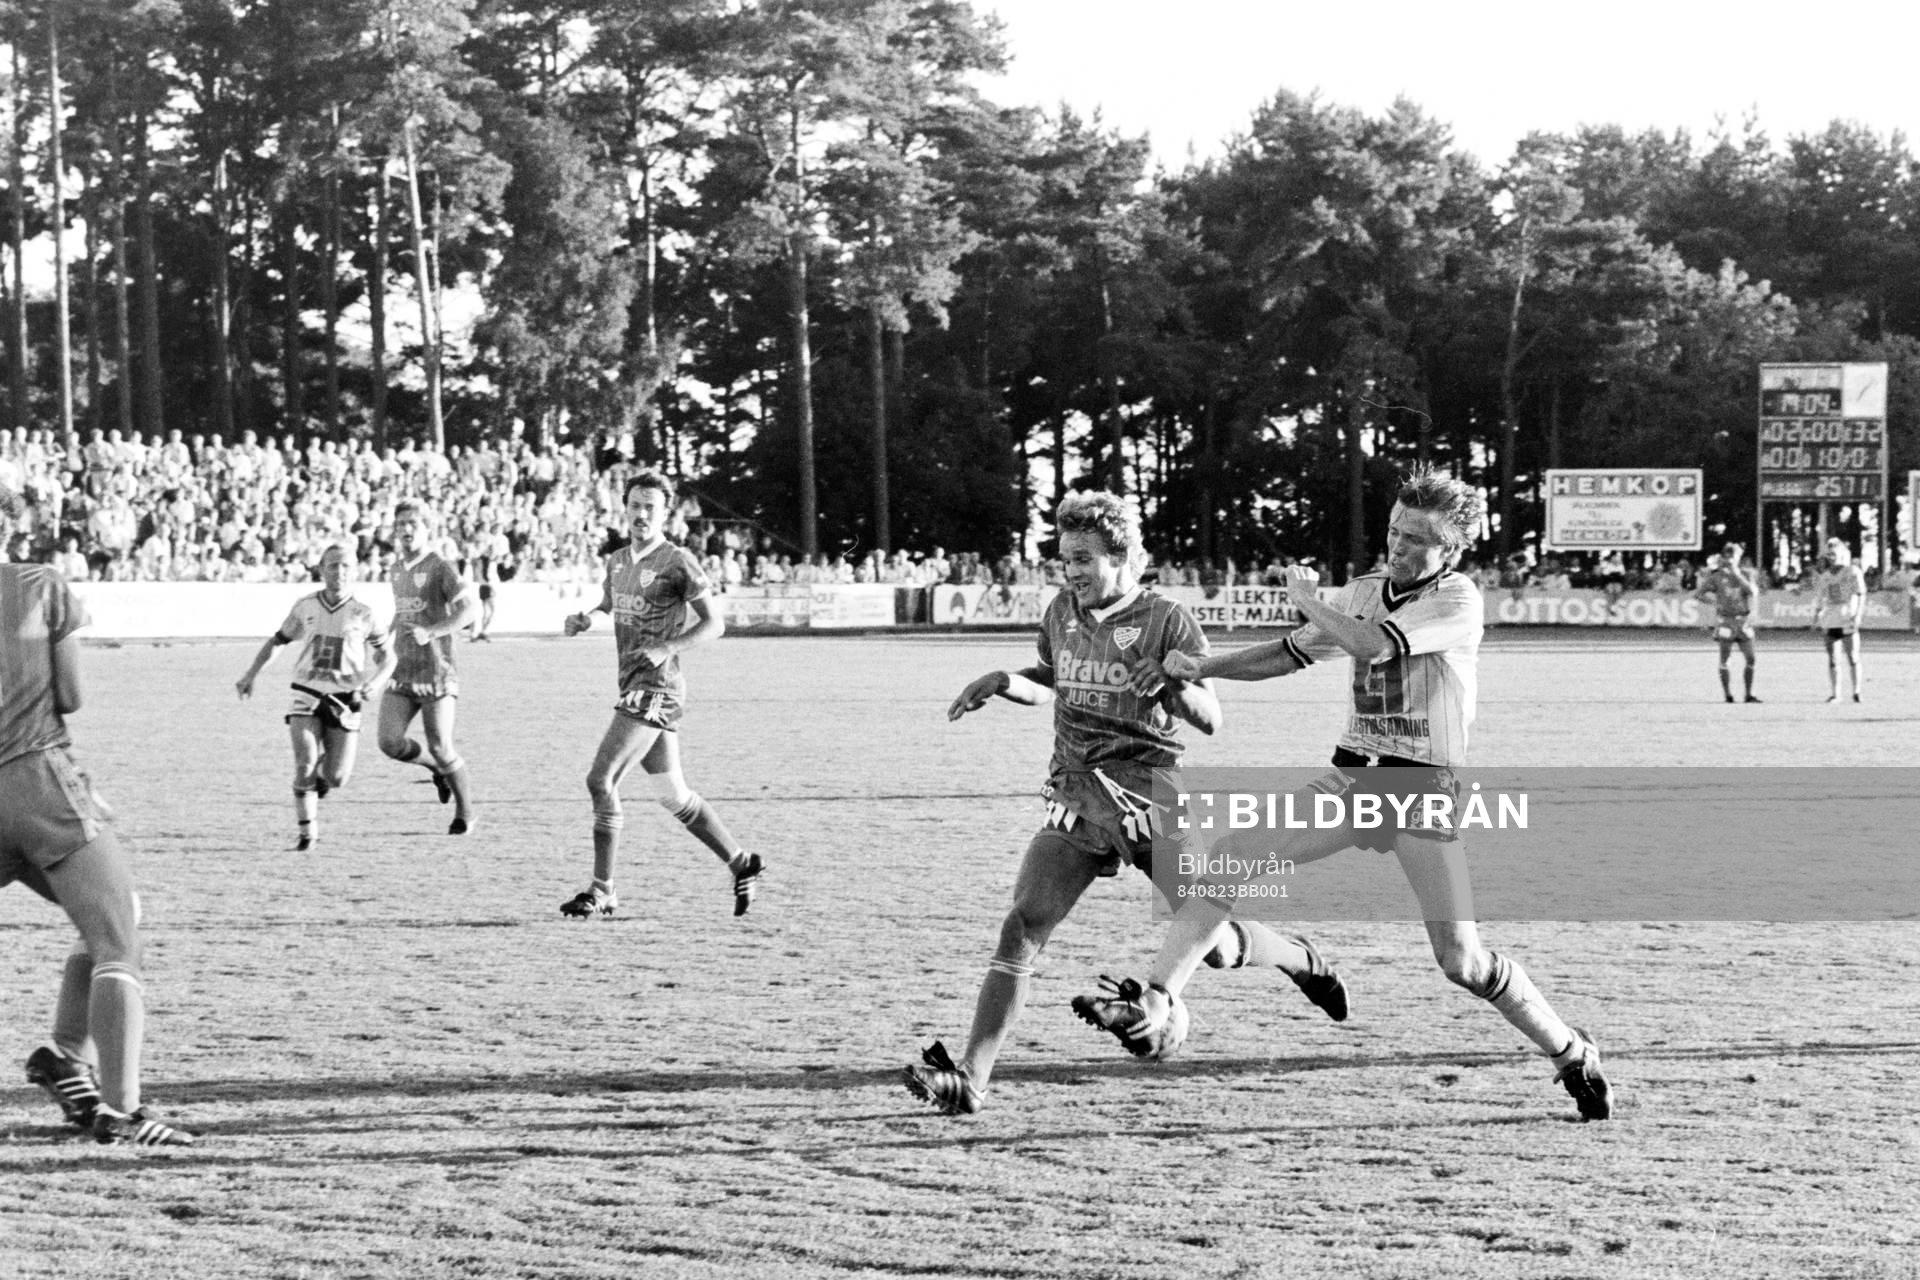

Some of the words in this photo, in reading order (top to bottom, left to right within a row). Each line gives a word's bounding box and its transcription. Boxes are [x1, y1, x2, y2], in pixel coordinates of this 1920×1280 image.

[1499, 597, 1699, 624] OTTOSSONS
[1057, 650, 1128, 685] Bravo
[1066, 690, 1110, 708] JUICE
